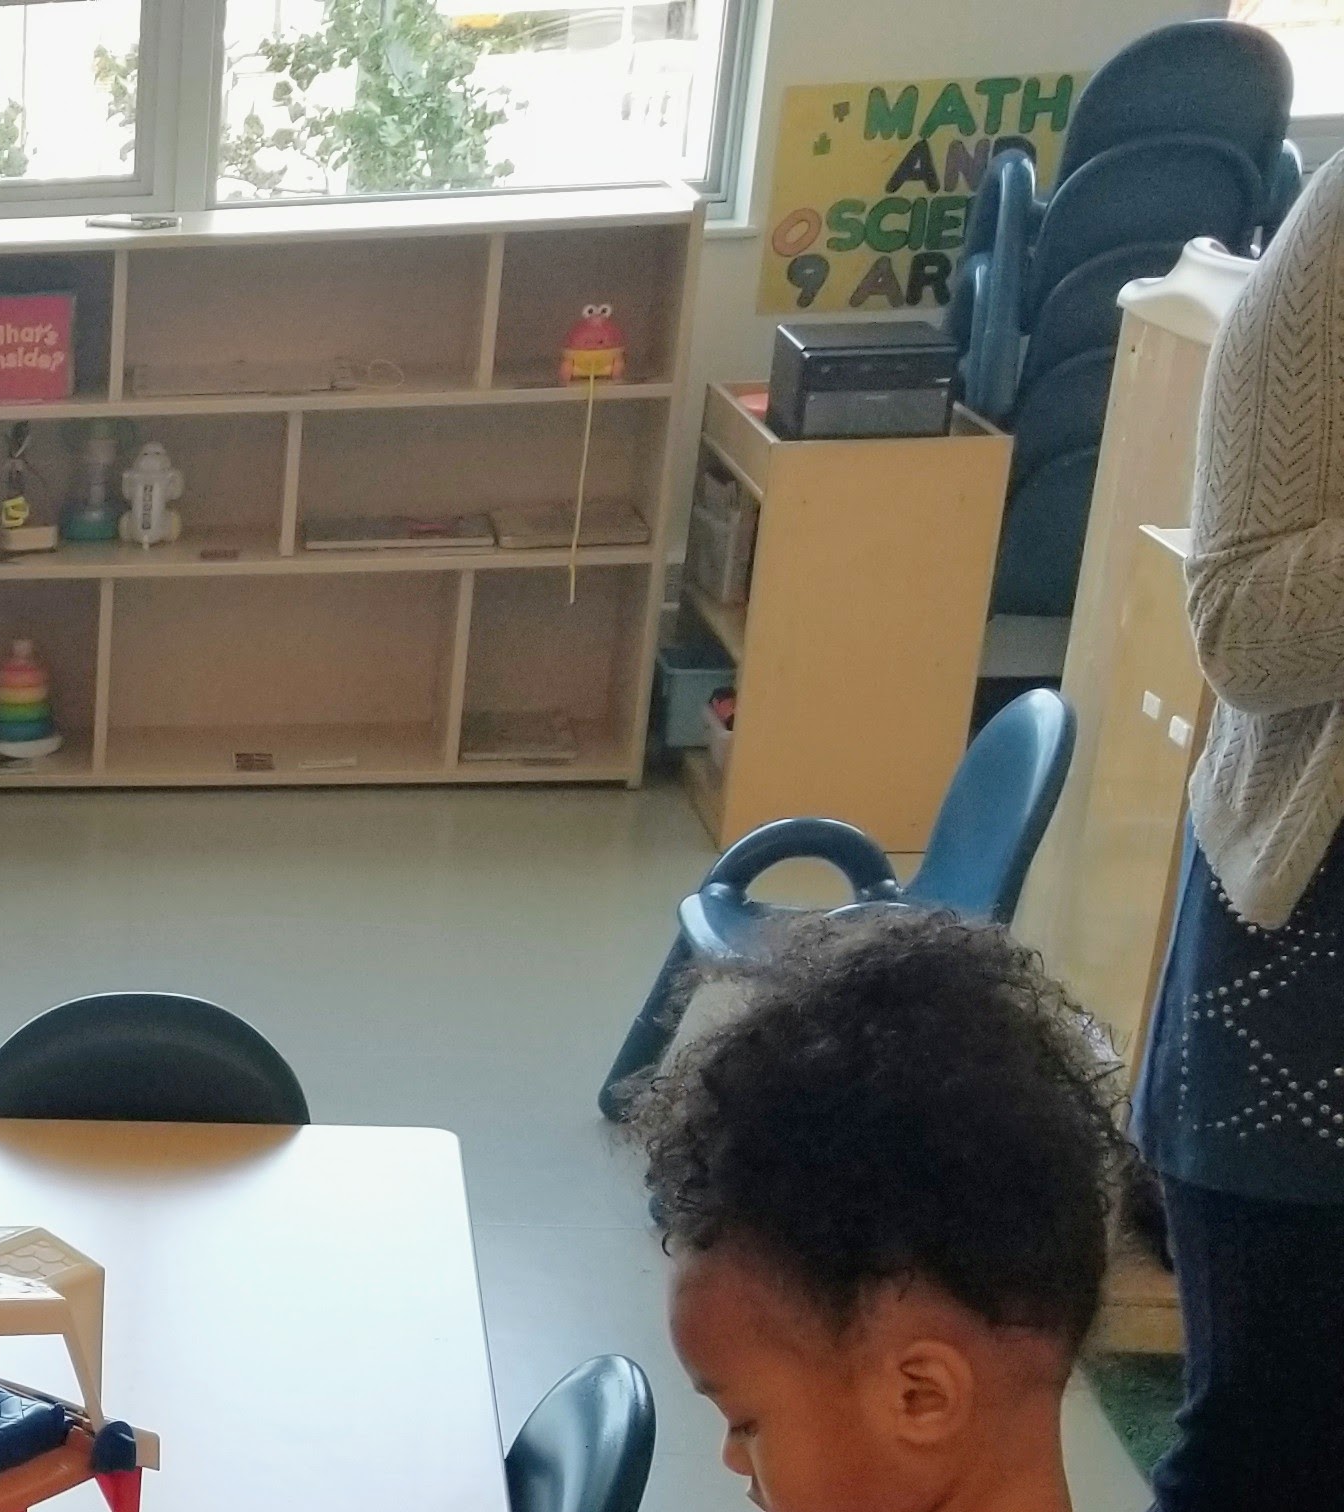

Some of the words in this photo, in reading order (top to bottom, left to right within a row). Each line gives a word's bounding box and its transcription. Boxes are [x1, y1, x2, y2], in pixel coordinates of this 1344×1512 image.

[864, 74, 1073, 140] MATH
[885, 135, 1037, 193] AN
[825, 195, 975, 253] SCIE
[848, 251, 953, 308] AR
